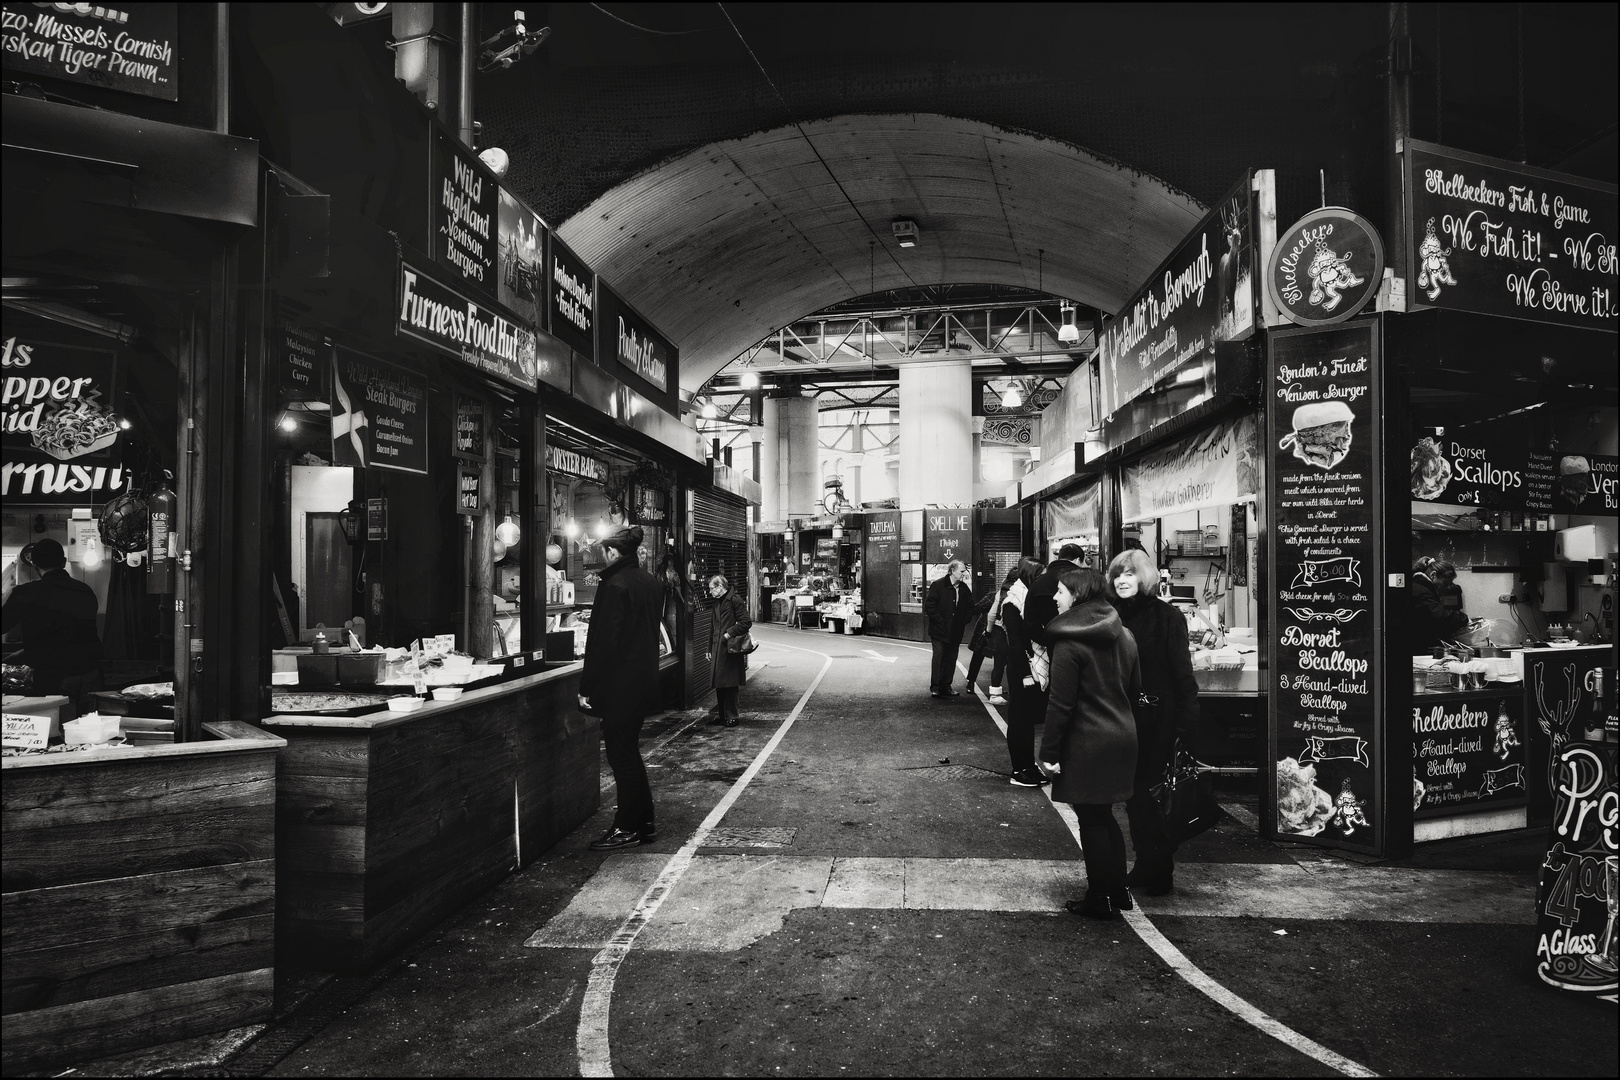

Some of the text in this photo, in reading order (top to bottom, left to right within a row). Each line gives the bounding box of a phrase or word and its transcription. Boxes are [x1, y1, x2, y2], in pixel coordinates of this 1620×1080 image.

[33, 13, 108, 49] Mussels
[113, 31, 171, 66] Cornish
[56, 41, 107, 75] Tiger
[454, 154, 482, 205] Wild
[442, 177, 490, 241] Highland
[1425, 169, 1591, 229] Shellseekers Fish & Game
[1442, 210, 1488, 251] We
[1480, 221, 1520, 258] Fish
[1522, 230, 1541, 263] it!
[1564, 233, 1605, 271] We
[446, 237, 484, 282] Burgers
[1280, 223, 1334, 305] Shellseekers
[1148, 290, 1160, 329] to
[1161, 232, 1213, 320] Borough
[1507, 268, 1610, 318] We Serve it!
[400, 269, 519, 363] Furness Food Hut
[559, 289, 586, 331] Fresh Fish
[286, 337, 316, 357] Malaysian
[618, 315, 665, 384] Poultry & Game
[289, 353, 313, 370] Chicken
[461, 345, 501, 375] Freshly Prepared
[1277, 356, 1368, 384] London's Finest
[292, 369, 310, 386] Curry
[2, 376, 92, 405] pper
[366, 385, 417, 414] Steak Burgers
[1277, 383, 1368, 402] Venison Burger
[390, 417, 405, 430] Cheese
[376, 443, 399, 457] Bacon Jam
[553, 446, 580, 475] OYSTER
[1451, 441, 1486, 460] Dorset
[1283, 471, 1362, 484] made from the finest venison
[1453, 458, 1522, 492] Scallops
[1151, 478, 1216, 511] Hunter Gatherer
[1284, 487, 1300, 495] meat
[1300, 485, 1317, 495] which
[1323, 485, 1345, 494] sourced
[1344, 485, 1361, 495] from
[1305, 498, 1319, 507] wild
[1333, 498, 1347, 506] deer
[1347, 497, 1364, 506] herds
[1526, 500, 1554, 509] Crispy Bacon
[929, 515, 968, 532] SMELL ME
[1307, 510, 1338, 519] in Dorset
[1278, 523, 1369, 536] This Gourmet Burger is served
[1285, 537, 1298, 545] with
[1297, 536, 1313, 547] fresh
[1313, 536, 1330, 545] salad
[1331, 536, 1336, 544] &
[1342, 536, 1361, 544] choice
[1303, 547, 1342, 557] of condiments
[1280, 590, 1368, 603] Add cheese for only extra
[1280, 625, 1341, 648] Dorset
[1299, 649, 1368, 680] Scallops
[1280, 674, 1369, 695] 3 Hand-dived
[1300, 693, 1348, 715] Scallops
[1307, 714, 1340, 724] Served with
[1312, 721, 1317, 730] &
[1317, 723, 1334, 734] Crispy
[1334, 724, 1356, 733] Bacon
[1420, 736, 1484, 758] Hand-dived
[1426, 757, 1467, 779] Scallops
[1426, 783, 1442, 793] Served
[1536, 928, 1597, 964] A Glass
